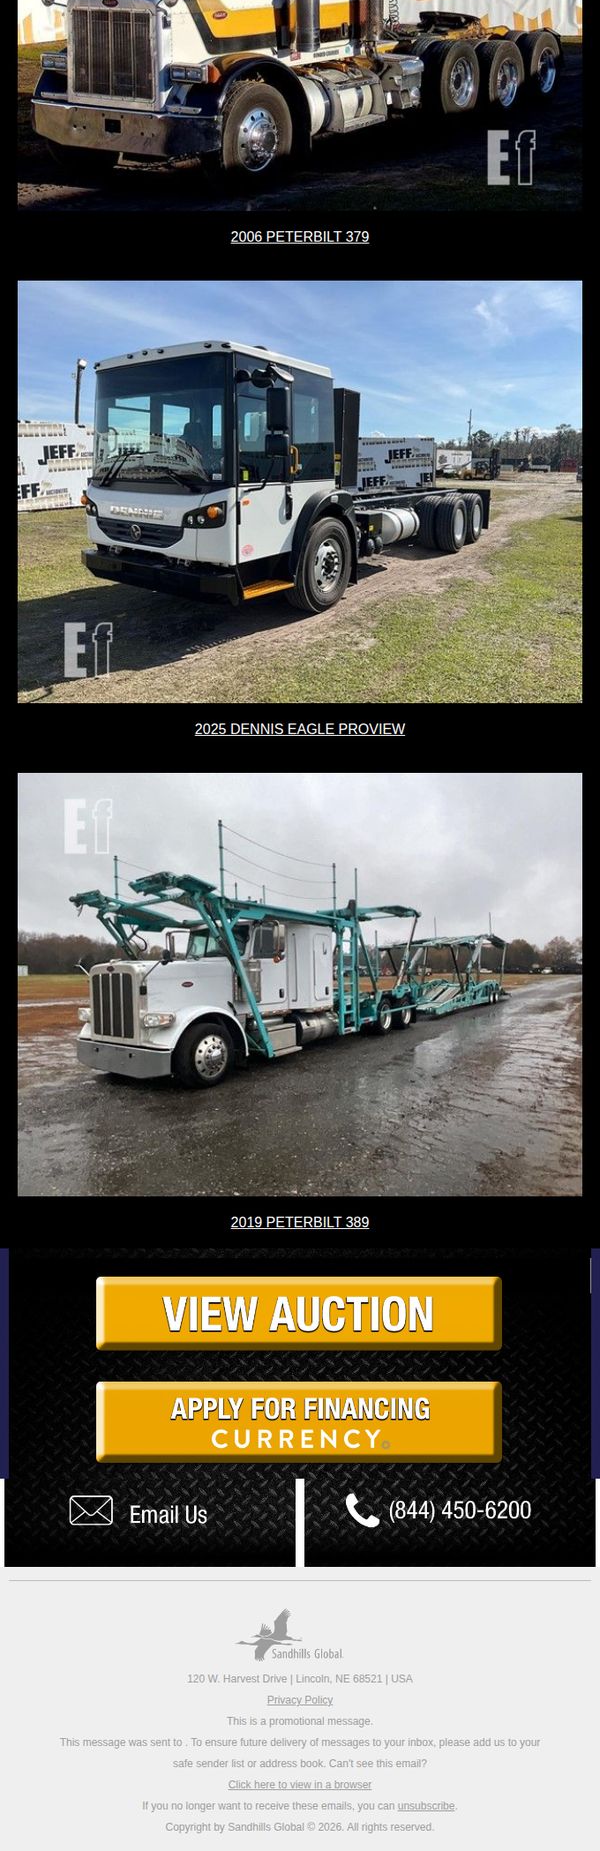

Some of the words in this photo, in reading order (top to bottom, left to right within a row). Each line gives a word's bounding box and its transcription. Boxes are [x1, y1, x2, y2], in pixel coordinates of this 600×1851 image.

[38, 444, 76, 465] JEFF
[385, 448, 412, 464] JEFF
[358, 475, 386, 492] JEFF
[163, 1296, 258, 1331] VIEW
[270, 1296, 432, 1331] AUCTION
[171, 1398, 243, 1419] APPLY
[252, 1398, 295, 1419] FOR
[305, 1398, 429, 1419] FINANCING
[212, 1429, 380, 1448] CURRENCY
[131, 1505, 178, 1524] Email
[186, 1505, 207, 1524] Us
[390, 1501, 435, 1523] (844)
[442, 1501, 531, 1519] 450-6200
[271, 1648, 311, 1659] Sandhills
[314, 1648, 342, 1659] Global
[188, 1673, 206, 1684] 120
[207, 1674, 221, 1684] W.
[223, 1674, 260, 1684] Harvest
[262, 1673, 288, 1684] Drive
[295, 1674, 332, 1685] Lincoln,
[335, 1673, 350, 1684] NE
[352, 1673, 382, 1684] 68521
[391, 1674, 413, 1684] USA
[267, 1695, 302, 1706] Privacy
[304, 1695, 334, 1706] Policy
[226, 1716, 247, 1726] This
[249, 1716, 258, 1726] is
[260, 1718, 267, 1726] a
[269, 1716, 325, 1728] promotional
[327, 1718, 373, 1729] message.
[165, 1822, 211, 1834] Copyright
[213, 1822, 226, 1834] by
[228, 1822, 271, 1832] Sandhills
[273, 1822, 305, 1832] Global
[318, 1822, 346, 1832] 2026.
[346, 1822, 359, 1832] All
[361, 1822, 388, 1834] rights
[390, 1822, 434, 1832] reserved.
